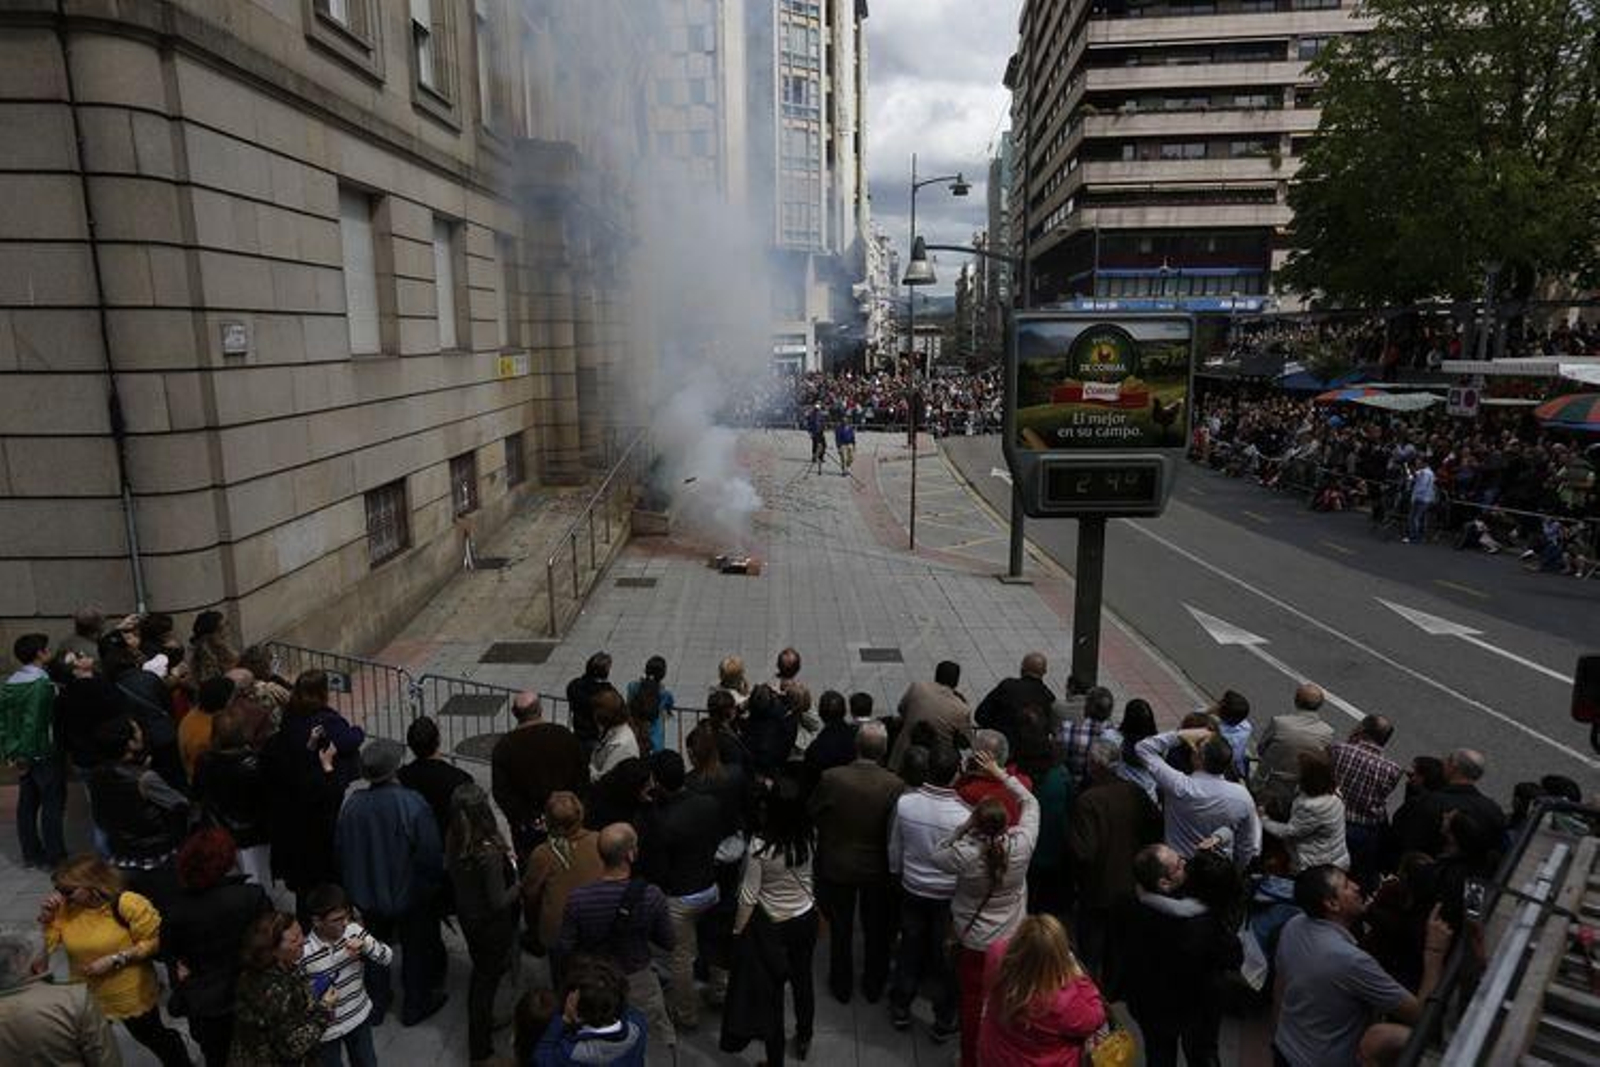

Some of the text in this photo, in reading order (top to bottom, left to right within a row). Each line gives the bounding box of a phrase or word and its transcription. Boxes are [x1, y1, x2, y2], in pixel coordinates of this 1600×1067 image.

[1073, 411, 1127, 427] El mejor
[1057, 426, 1144, 440] en su campo.
